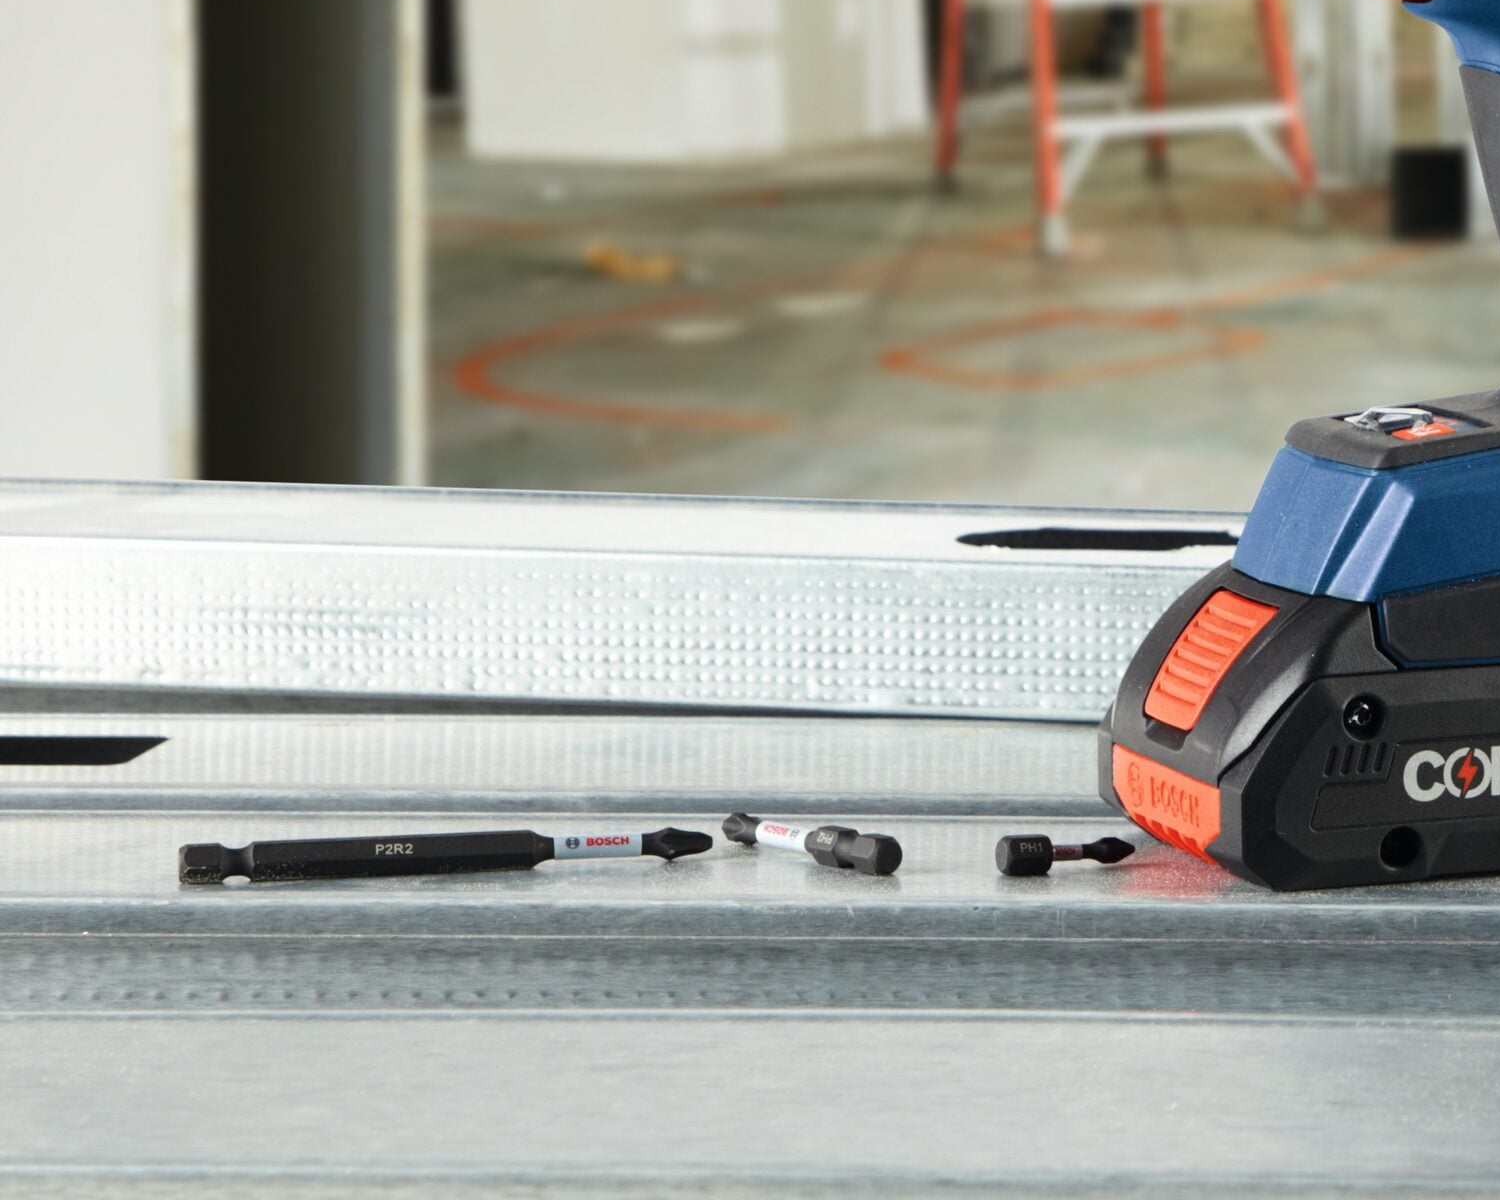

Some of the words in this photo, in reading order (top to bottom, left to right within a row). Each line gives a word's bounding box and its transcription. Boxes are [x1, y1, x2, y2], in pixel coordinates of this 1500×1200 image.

[1150, 776, 1200, 828] BOSCH
[586, 836, 630, 847] BOSCH
[816, 831, 834, 845] PH2
[375, 843, 414, 856] P2R2
[1020, 842, 1043, 853] PH1
